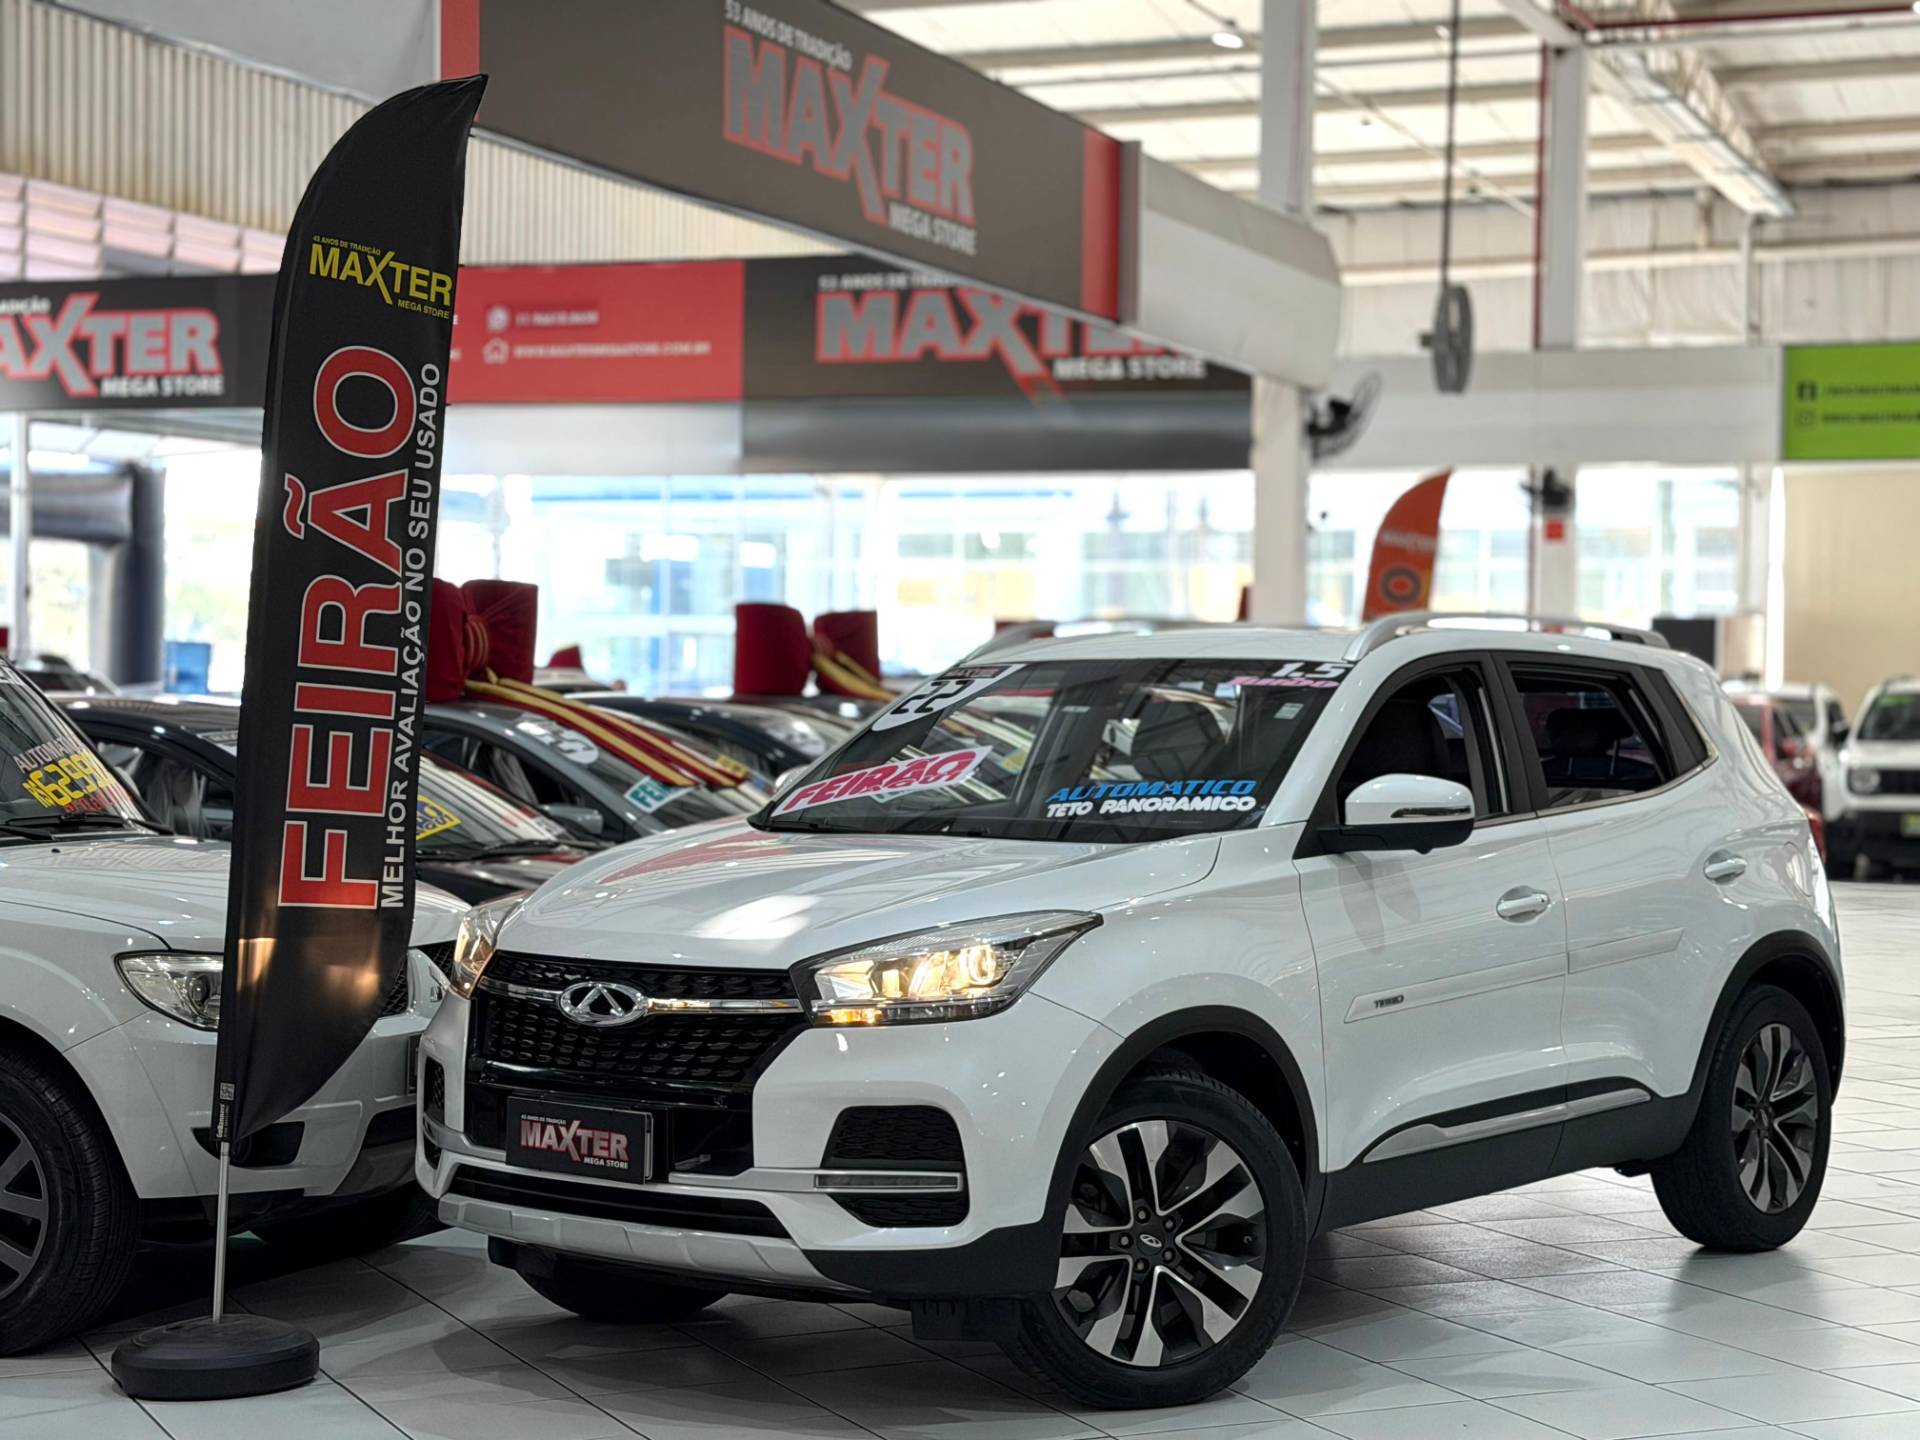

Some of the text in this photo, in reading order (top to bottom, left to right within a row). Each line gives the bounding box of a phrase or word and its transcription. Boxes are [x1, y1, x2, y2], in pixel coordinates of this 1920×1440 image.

[742, 6, 776, 39] ANOS
[777, 21, 794, 48] DE
[723, 24, 977, 227] MAXTER
[321, 236, 339, 246] ANOS
[340, 240, 348, 248] DE
[889, 200, 977, 256] MEGA STORE
[309, 243, 453, 306] MAXTER
[398, 299, 422, 312] MEGA
[423, 305, 450, 320] STORE
[0, 292, 225, 397] AXTER
[101, 375, 224, 397] MEGA STORE
[1053, 356, 1206, 380] MEGA STORE
[278, 345, 417, 909] FEIRÃO
[381, 363, 440, 908] MELHOR AVALIAÇÃO NO SEU USADO
[1271, 662, 1355, 678] 1.5
[1047, 796, 1257, 818] TETO PANORAMICO
[520, 1120, 629, 1162] MAXTER
[583, 1156, 629, 1169] MEGA STORE
